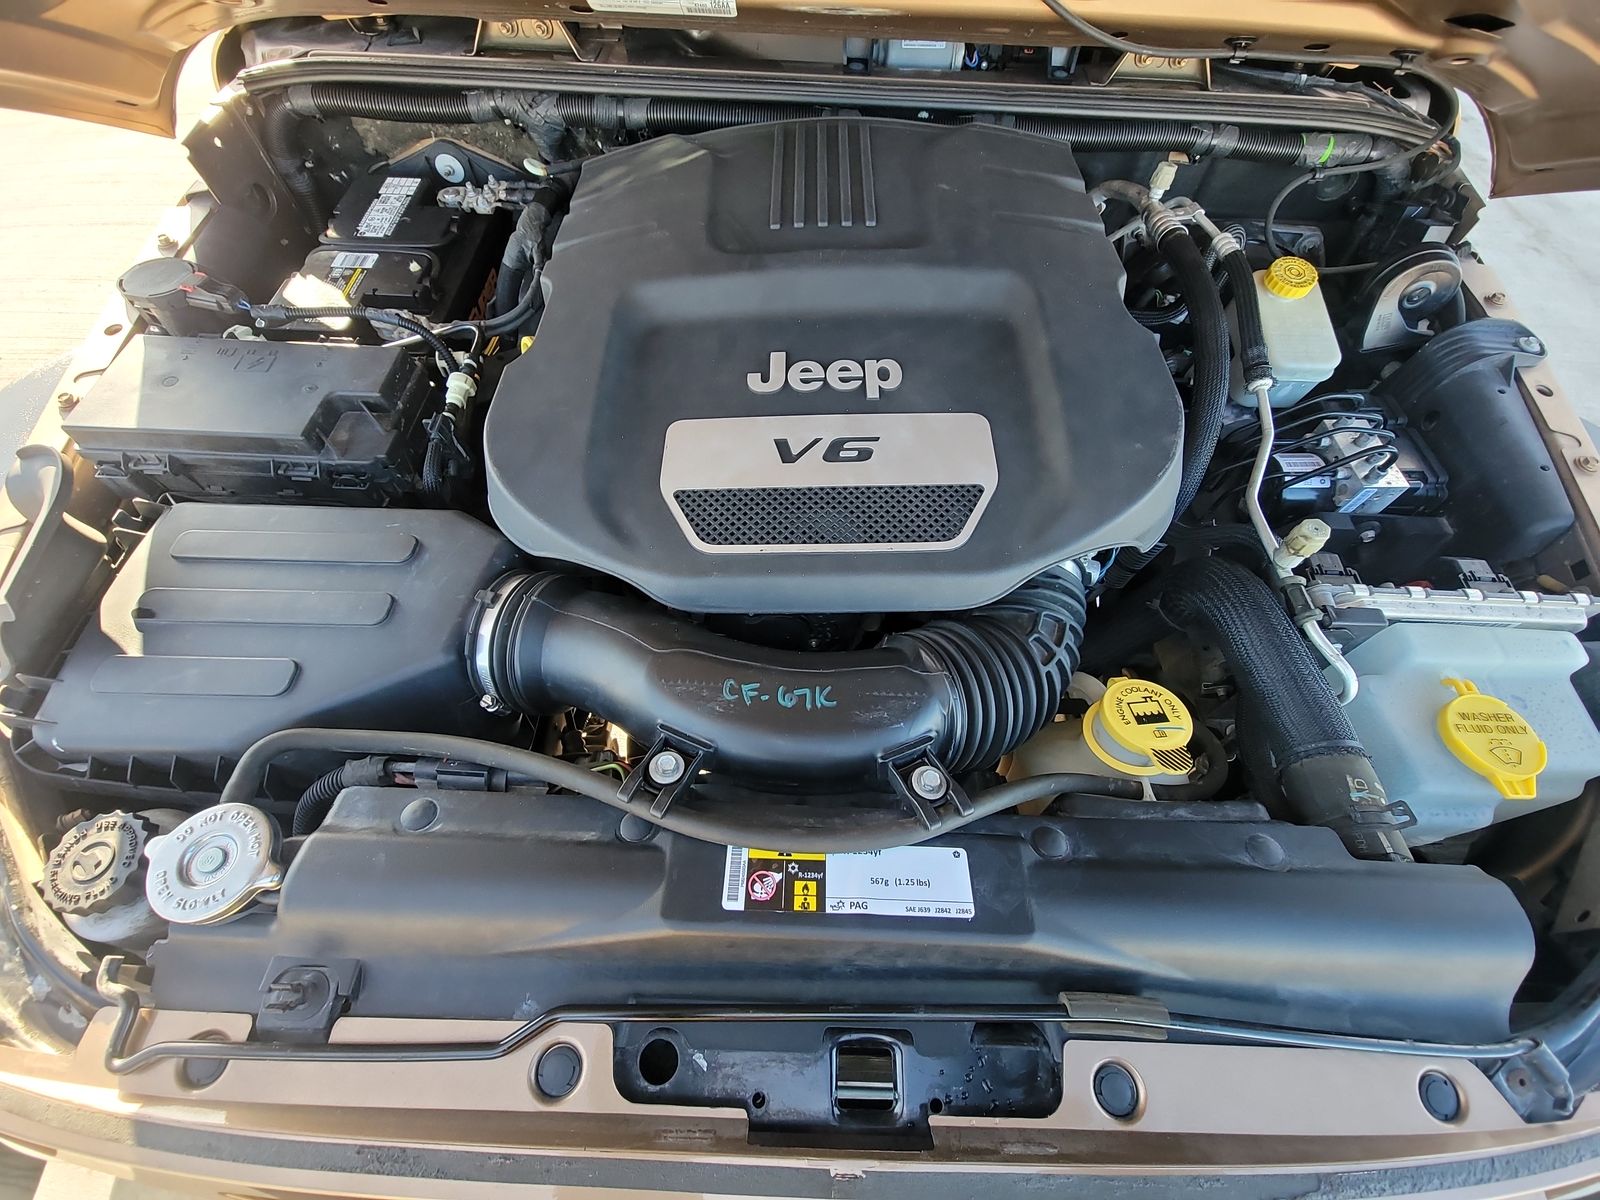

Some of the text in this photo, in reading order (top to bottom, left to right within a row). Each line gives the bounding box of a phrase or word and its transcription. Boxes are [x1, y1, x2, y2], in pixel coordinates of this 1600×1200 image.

[747, 351, 903, 400] Jeep
[773, 436, 881, 464] V6
[1115, 686, 1182, 726] ENGINE COOLANT ONLY
[1457, 712, 1515, 722] WASHER
[1455, 723, 1528, 735] FLUID ONLY
[200, 810, 227, 828] NOT
[230, 810, 259, 833] OPEN
[798, 871, 824, 881] R-1234yf
[156, 869, 174, 902] OPEN
[870, 877, 931, 888] 567g (1.25 lbs)
[849, 900, 869, 911] PAG
[917, 906, 931, 914] J639
